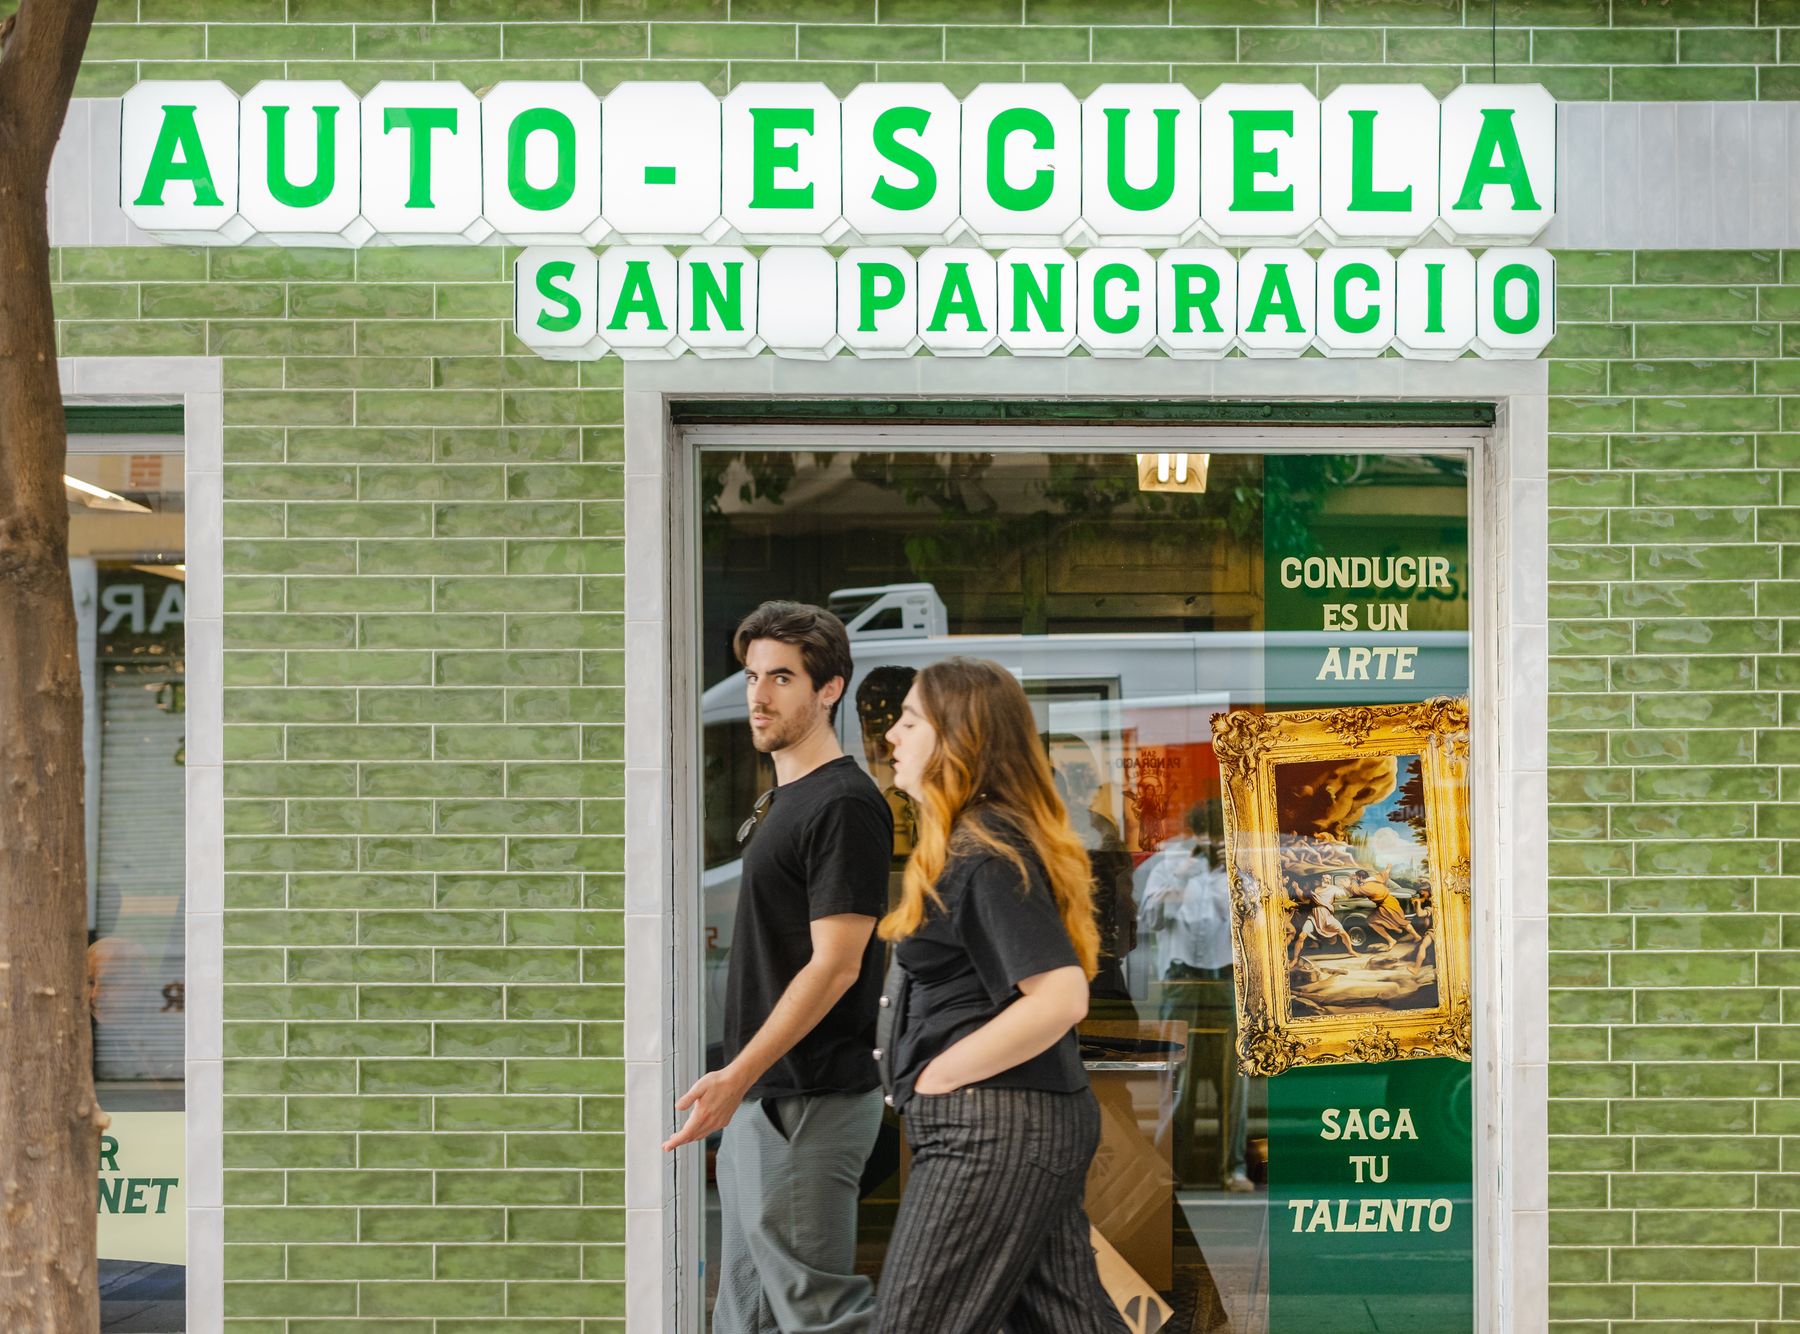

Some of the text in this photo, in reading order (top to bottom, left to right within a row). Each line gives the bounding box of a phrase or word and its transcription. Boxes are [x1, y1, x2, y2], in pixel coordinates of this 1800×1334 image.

[133, 104, 1542, 213] AUTO-ESCUELA
[535, 260, 1540, 335] SAN PANCRACIO
[1280, 556, 1452, 589] CONDUCIR
[1322, 603, 1409, 632] ES UN
[1315, 647, 1419, 681] ARTE
[1319, 1108, 1419, 1141] SACA
[1348, 1155, 1390, 1184] TU
[1287, 1197, 1454, 1233] TALENTO
